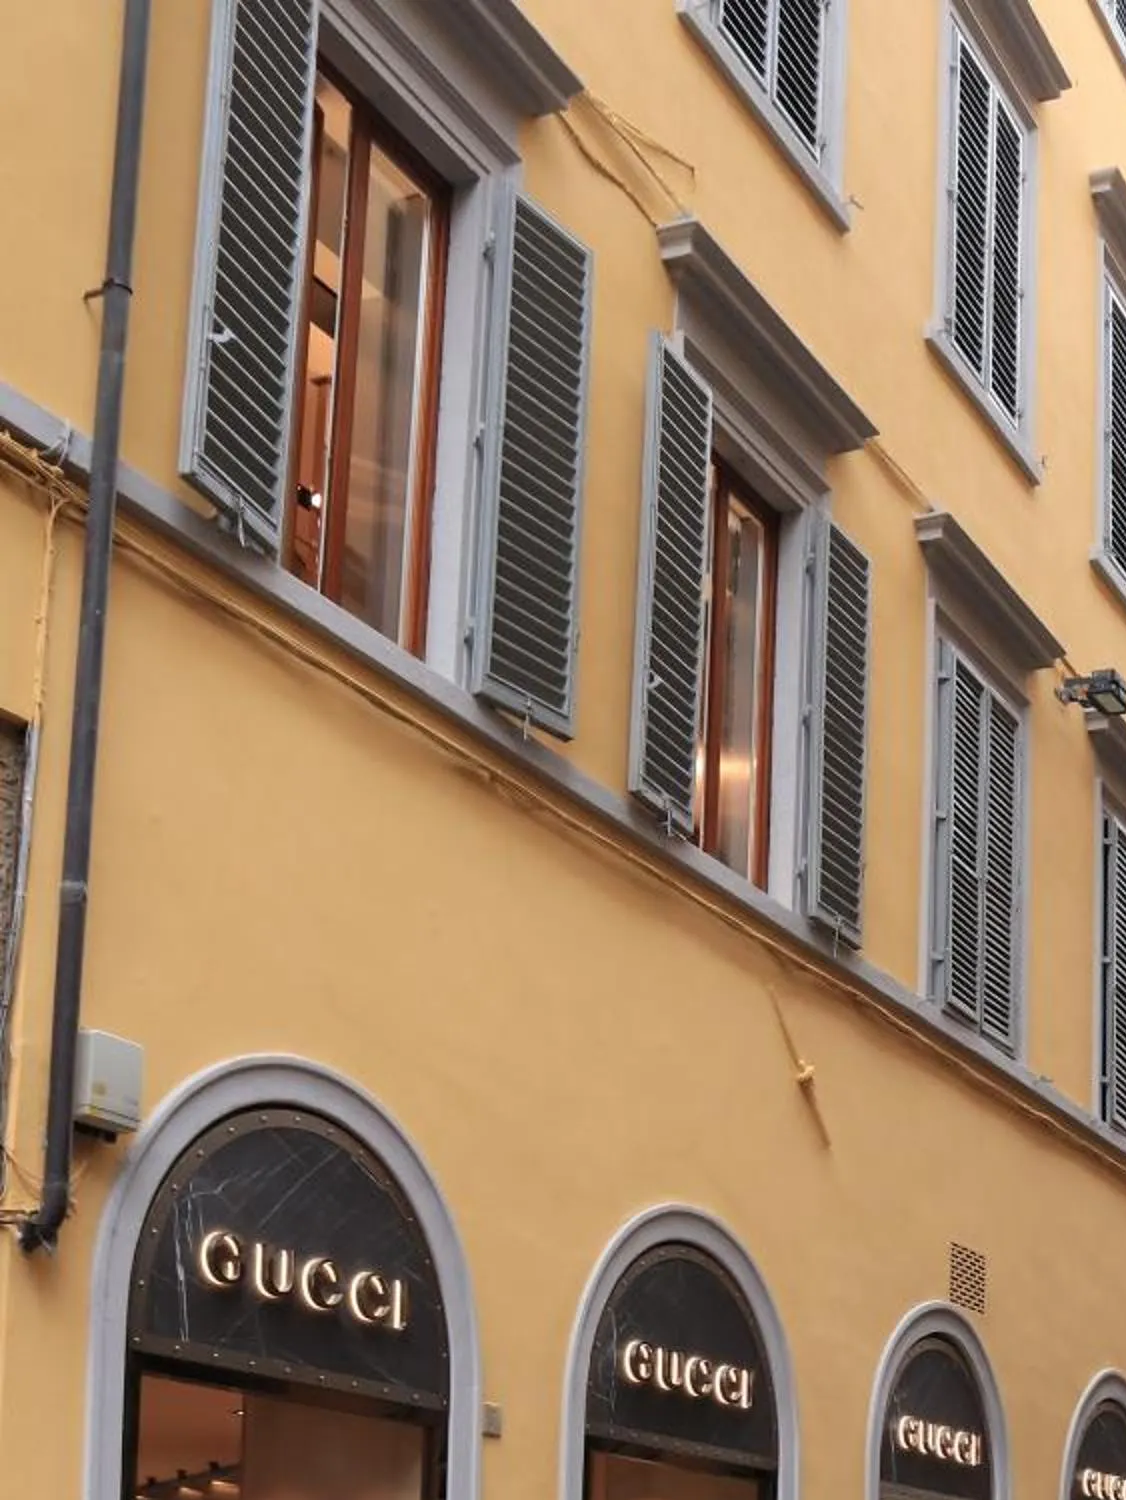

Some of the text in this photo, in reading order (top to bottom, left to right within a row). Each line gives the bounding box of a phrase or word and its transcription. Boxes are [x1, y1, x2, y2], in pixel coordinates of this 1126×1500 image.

[200, 1231, 408, 1330] GUCCI
[624, 1340, 753, 1409] GUCCI
[898, 1415, 981, 1467] GUCCI
